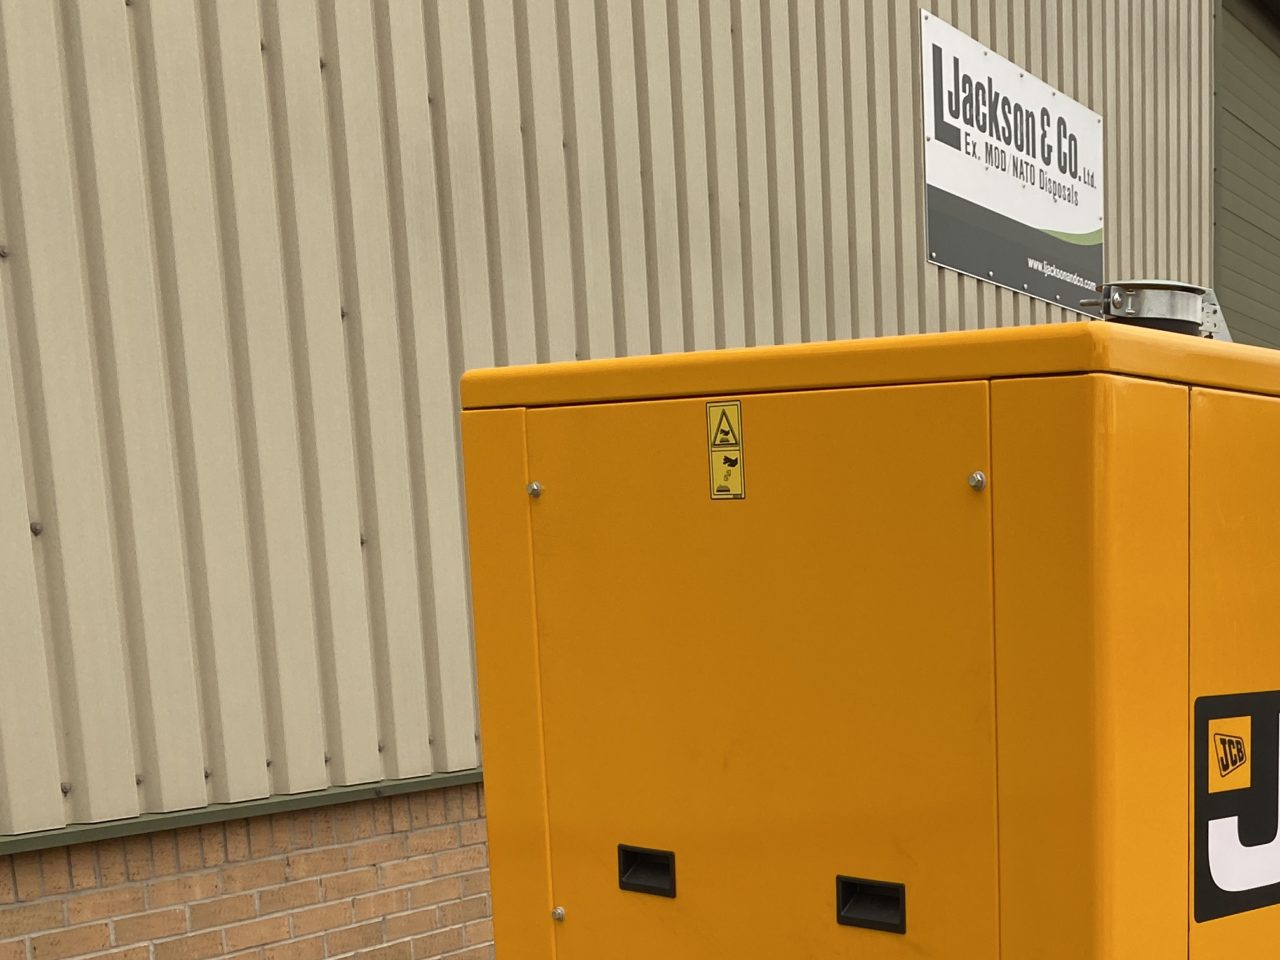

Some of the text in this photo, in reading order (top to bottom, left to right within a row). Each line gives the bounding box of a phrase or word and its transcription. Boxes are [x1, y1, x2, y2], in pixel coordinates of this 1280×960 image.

[964, 131, 981, 160] Ex.
[1039, 168, 1079, 207] Disposals
[1040, 107, 1053, 167] &
[1057, 116, 1082, 182] Co.
[1083, 166, 1097, 190] Ltd.
[1219, 737, 1245, 772] JCB
